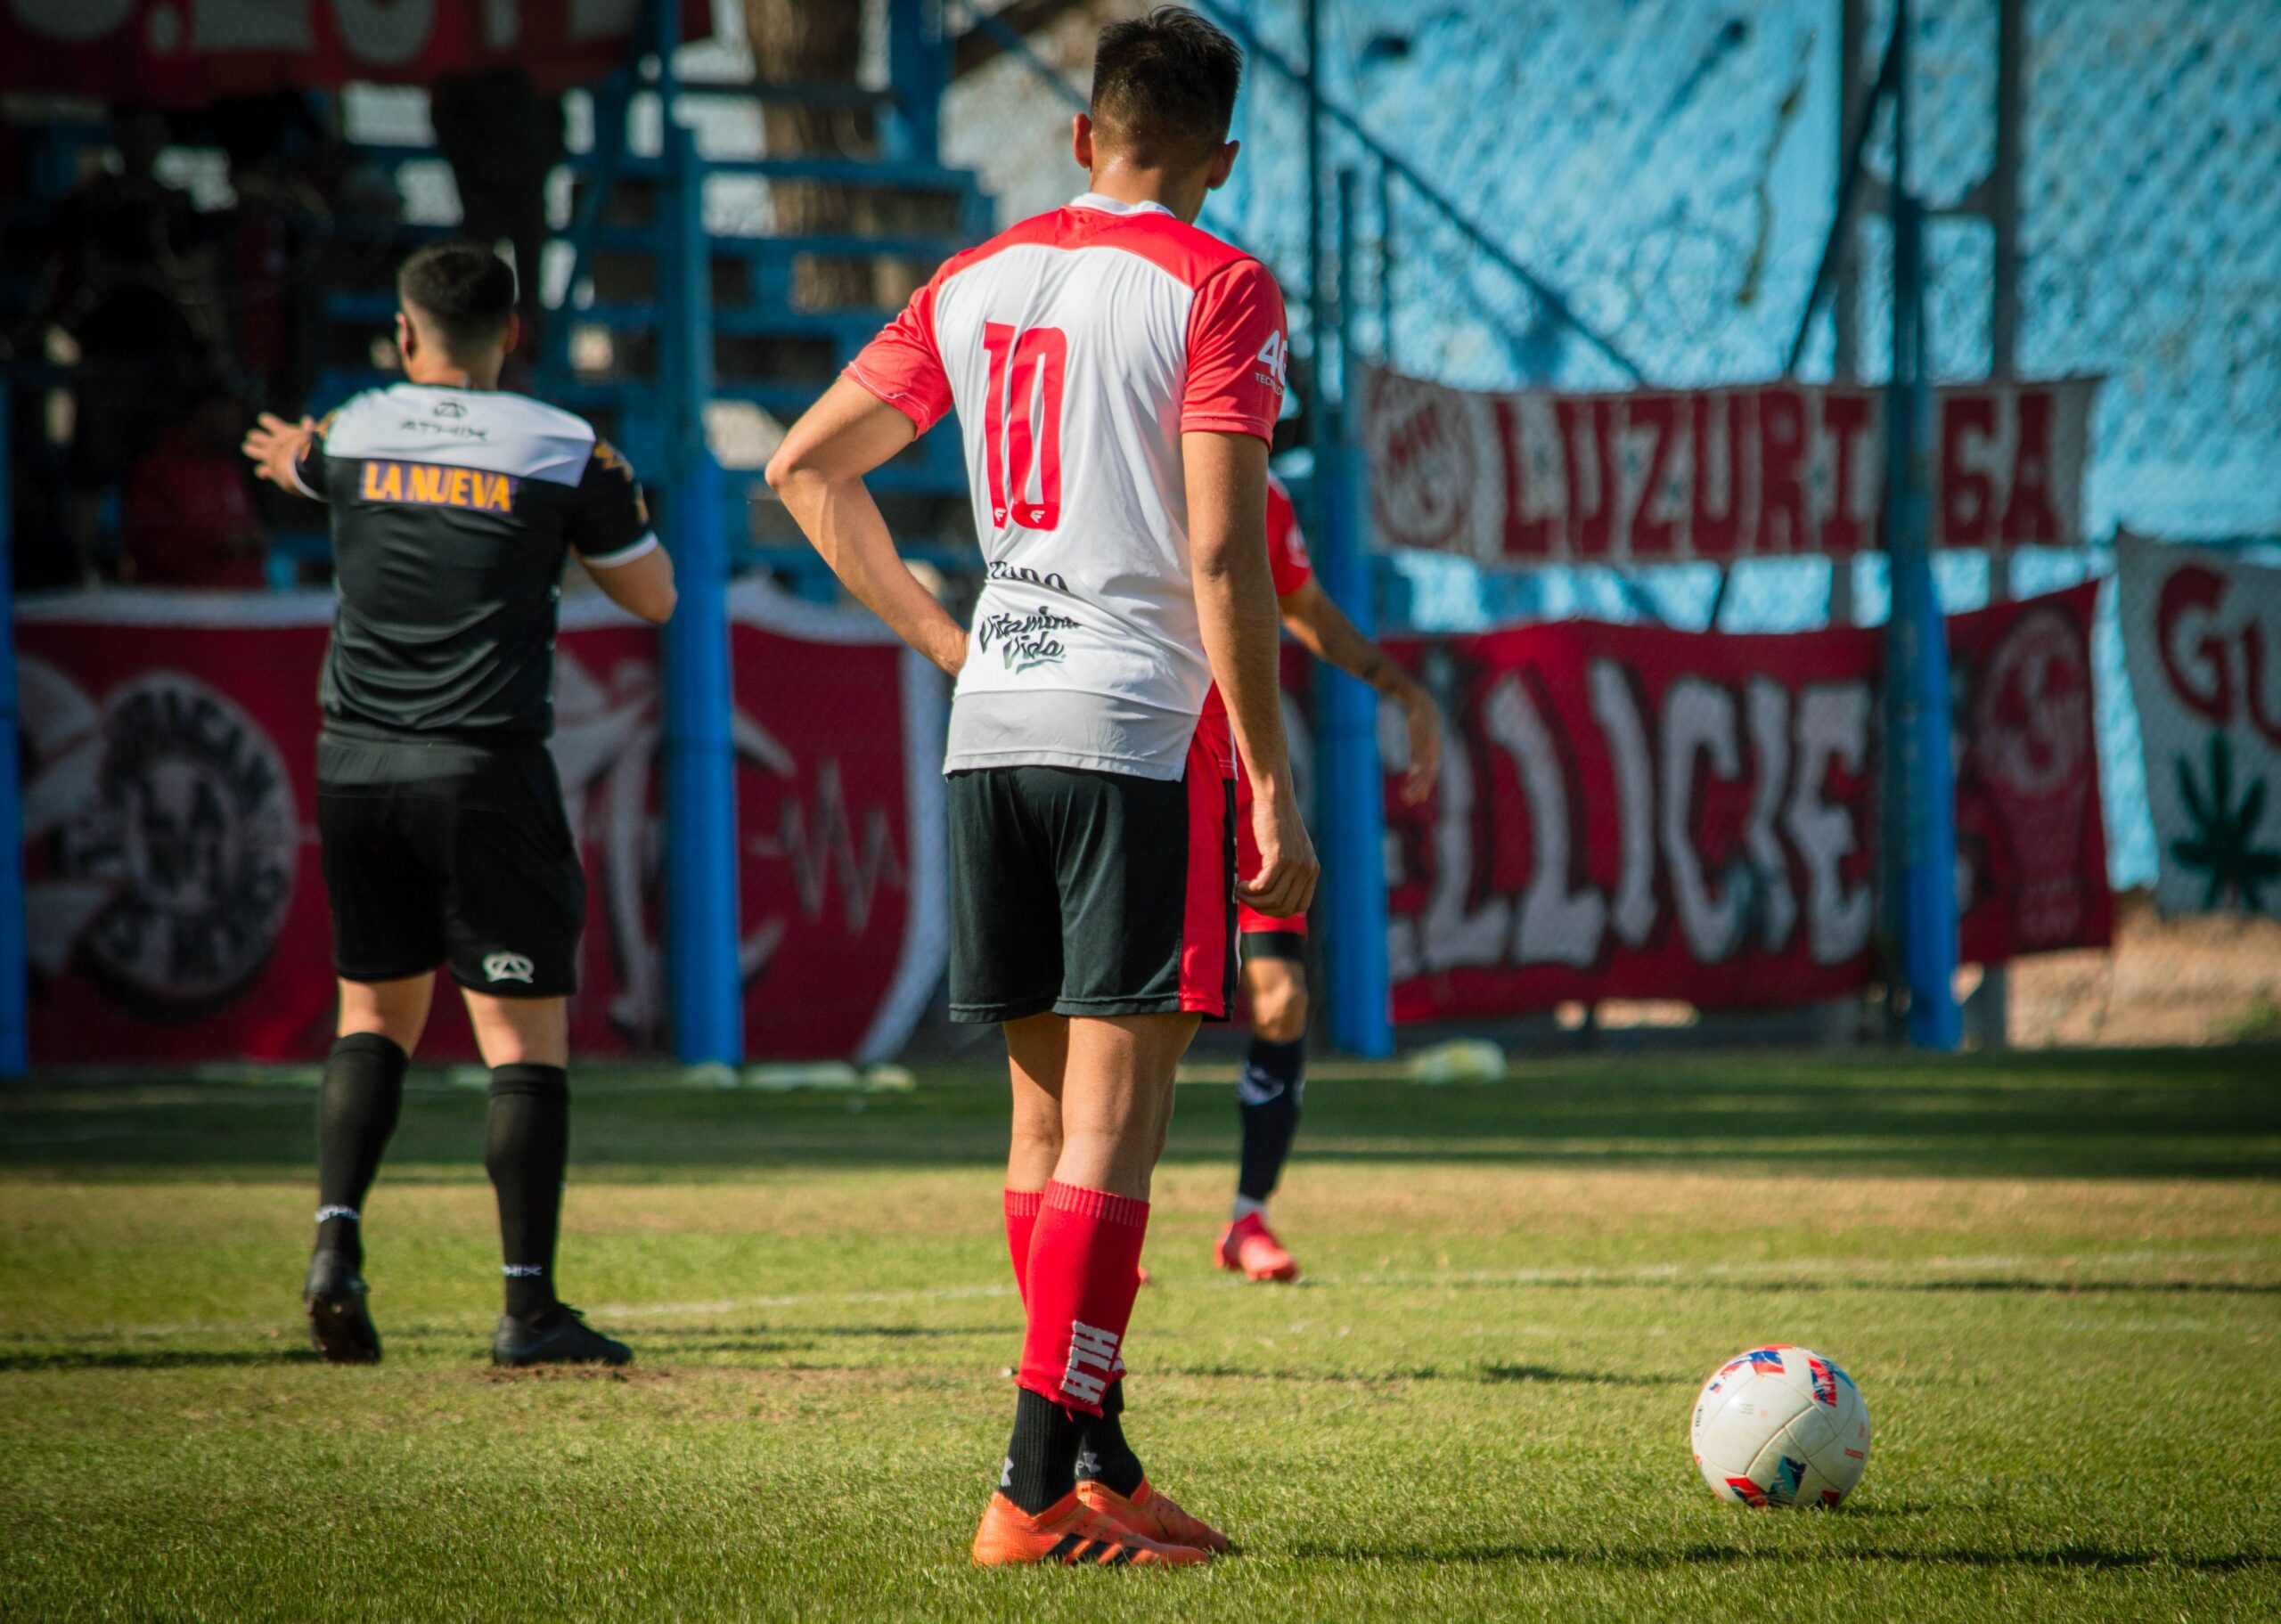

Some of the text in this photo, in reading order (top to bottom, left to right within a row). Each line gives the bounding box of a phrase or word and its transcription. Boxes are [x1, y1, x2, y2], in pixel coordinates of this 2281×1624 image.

[364, 462, 511, 513] LA NUEVA
[984, 322, 1067, 532] 10
[1494, 390, 2063, 554] LUZURIGA
